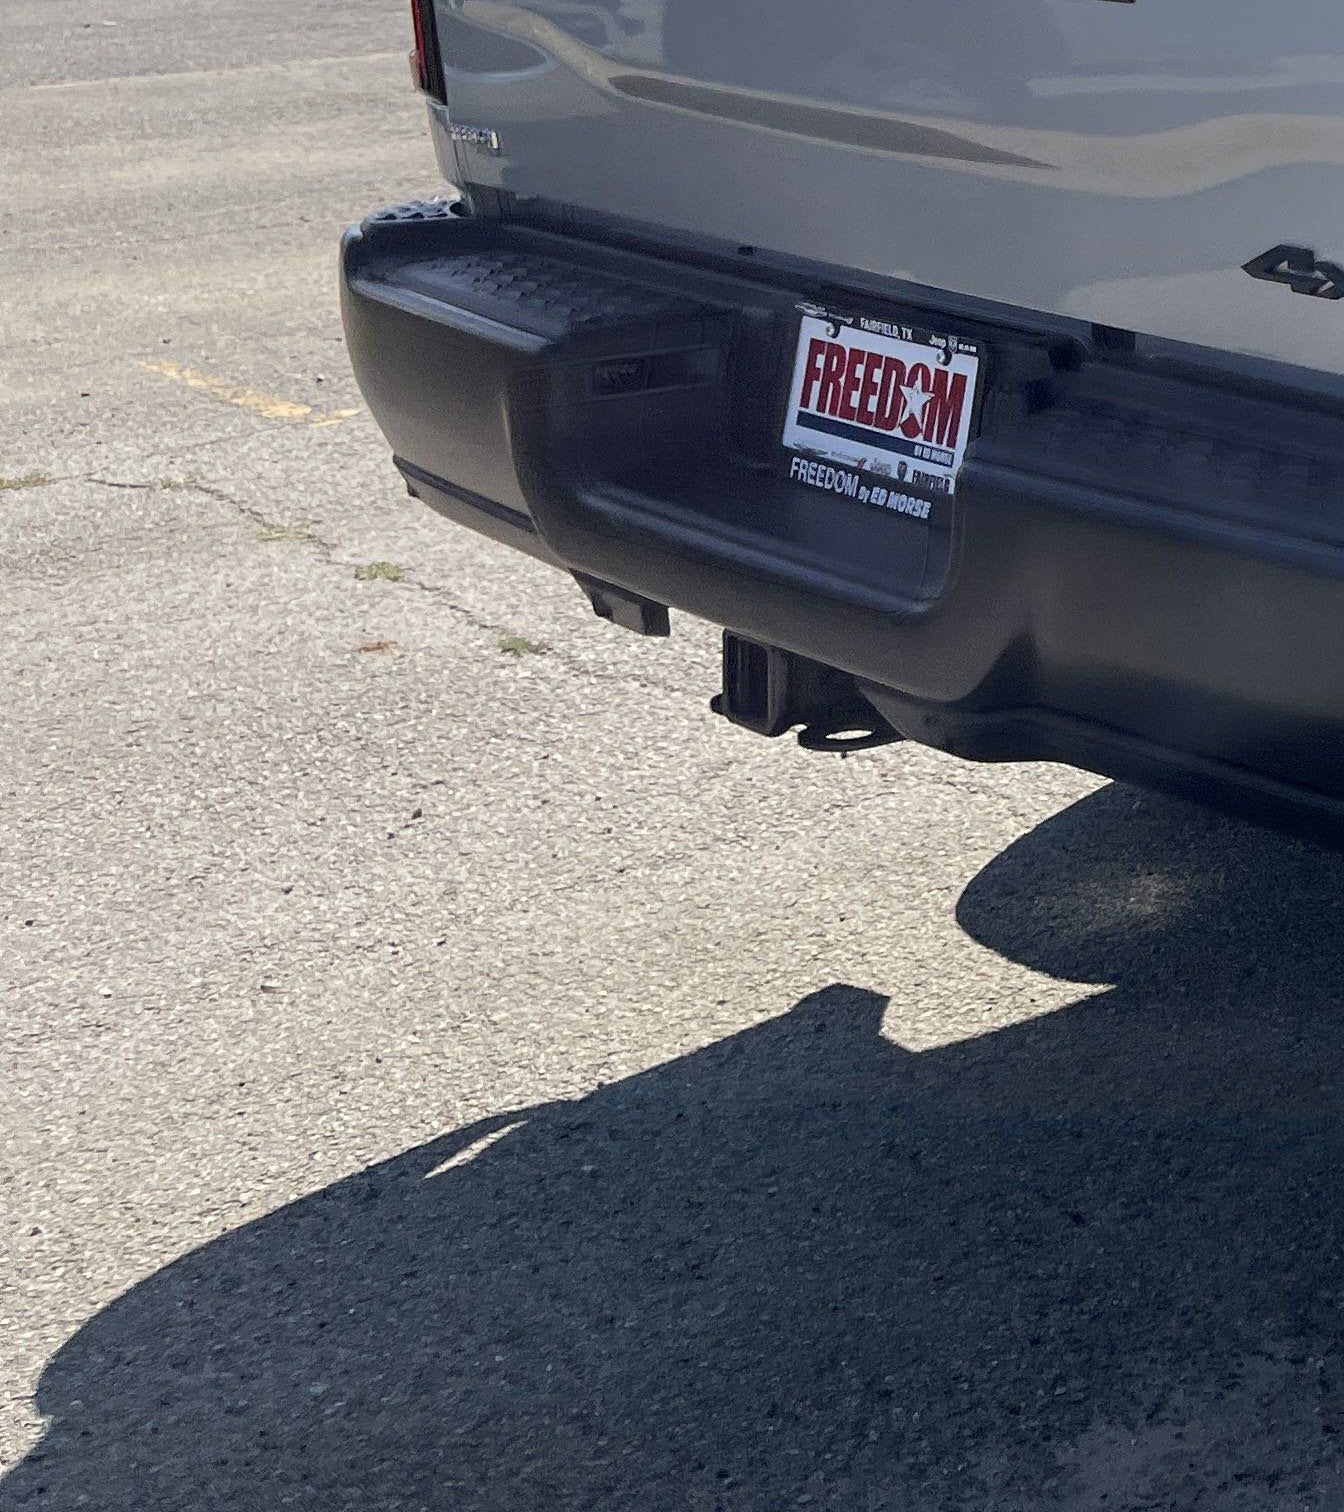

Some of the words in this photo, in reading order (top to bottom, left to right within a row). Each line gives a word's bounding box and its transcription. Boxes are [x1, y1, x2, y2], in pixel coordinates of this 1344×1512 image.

[860, 317, 900, 338] FAIRFIELD,
[901, 328, 913, 341] TX
[800, 338, 968, 449] FREEDOM
[789, 456, 860, 498] FREEDOM
[870, 486, 888, 507] ED
[886, 491, 932, 519] MORSE
